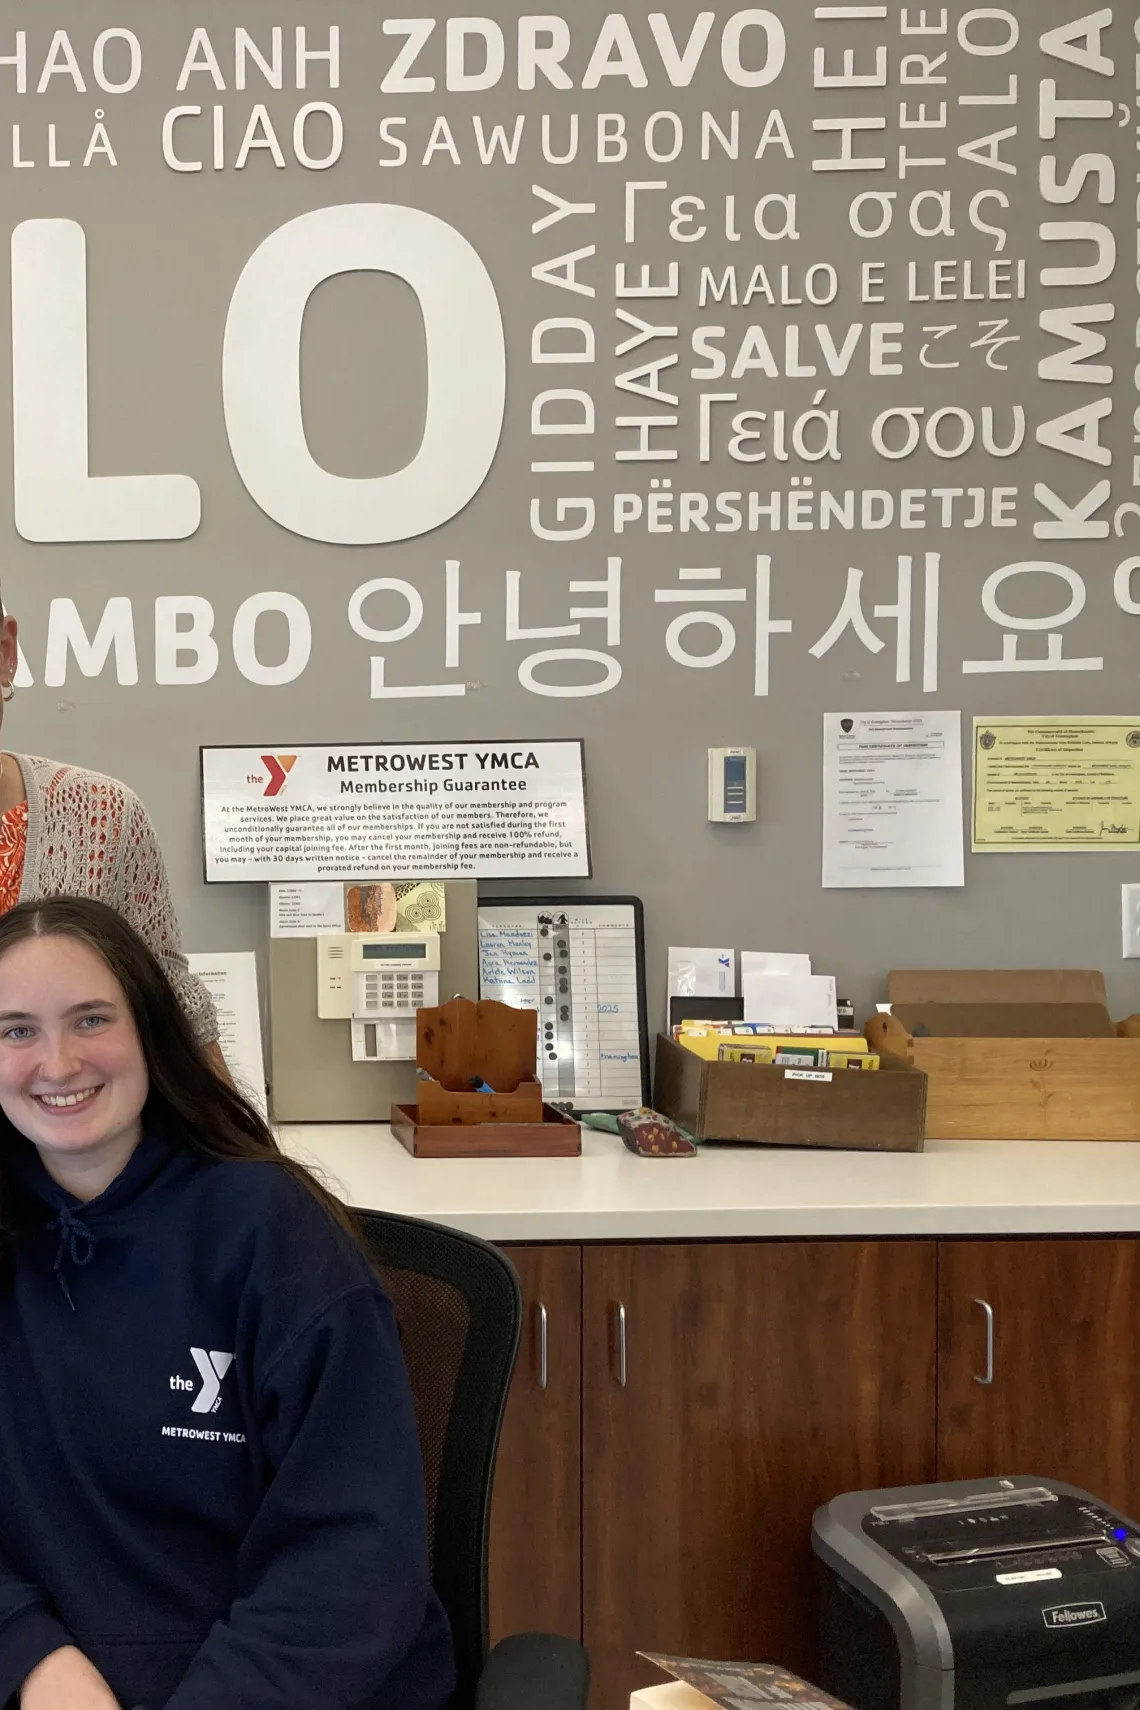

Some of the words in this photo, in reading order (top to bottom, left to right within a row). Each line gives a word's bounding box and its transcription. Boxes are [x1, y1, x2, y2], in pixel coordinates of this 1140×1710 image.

[176, 26, 340, 91] ANH
[380, 8, 786, 94] ZDRAVO
[812, 6, 888, 171] HEI
[899, 8, 948, 179] TERE
[957, 8, 1020, 175] ALO
[162, 101, 343, 172] CIAO
[378, 109, 795, 168] SAWUBONA
[625, 181, 800, 242] Γεια
[849, 189, 1010, 251] σας
[698, 263, 838, 307] MALO
[861, 262, 885, 303] E
[908, 259, 1026, 301] LELEI
[1034, 8, 1116, 539] KAMUSTA
[529, 184, 596, 542] GIDDAY
[615, 261, 679, 461] HAYE
[690, 322, 904, 380] SALVE
[700, 388, 842, 462] Γειά
[871, 405, 1026, 459] σου
[613, 476, 1018, 534] PËRSHËNDETJE
[246, 774, 264, 784] the
[327, 753, 468, 773] METROWEST
[475, 752, 540, 770] YMCA
[340, 778, 438, 795] Membership
[444, 778, 527, 791] Guarantee
[224, 825, 283, 834] unconditionally
[285, 825, 324, 833] guarantee
[471, 821, 505, 829] satisfied
[506, 820, 532, 829] during
[289, 814, 309, 823] place
[382, 812, 429, 820] satisfaction
[329, 804, 361, 812] strongly
[415, 802, 442, 811] quality
[469, 801, 516, 810] membership
[534, 801, 566, 809] program
[272, 854, 283, 862] 30
[284, 854, 303, 863] days
[408, 852, 447, 860] remainder
[478, 851, 525, 859] membership
[275, 844, 301, 853] capital
[303, 844, 329, 852] joining
[385, 842, 401, 850] first
[432, 842, 459, 850] joining
[461, 841, 477, 849] fees
[413, 832, 461, 840] membership
[509, 830, 532, 838] 100%
[317, 864, 351, 872] prorated
[411, 862, 458, 870] membership
[169, 1375, 194, 1391] the
[161, 1426, 221, 1442] METROWEST
[223, 1432, 246, 1443] YMCA
[1052, 1609, 1098, 1623] Fellowes
